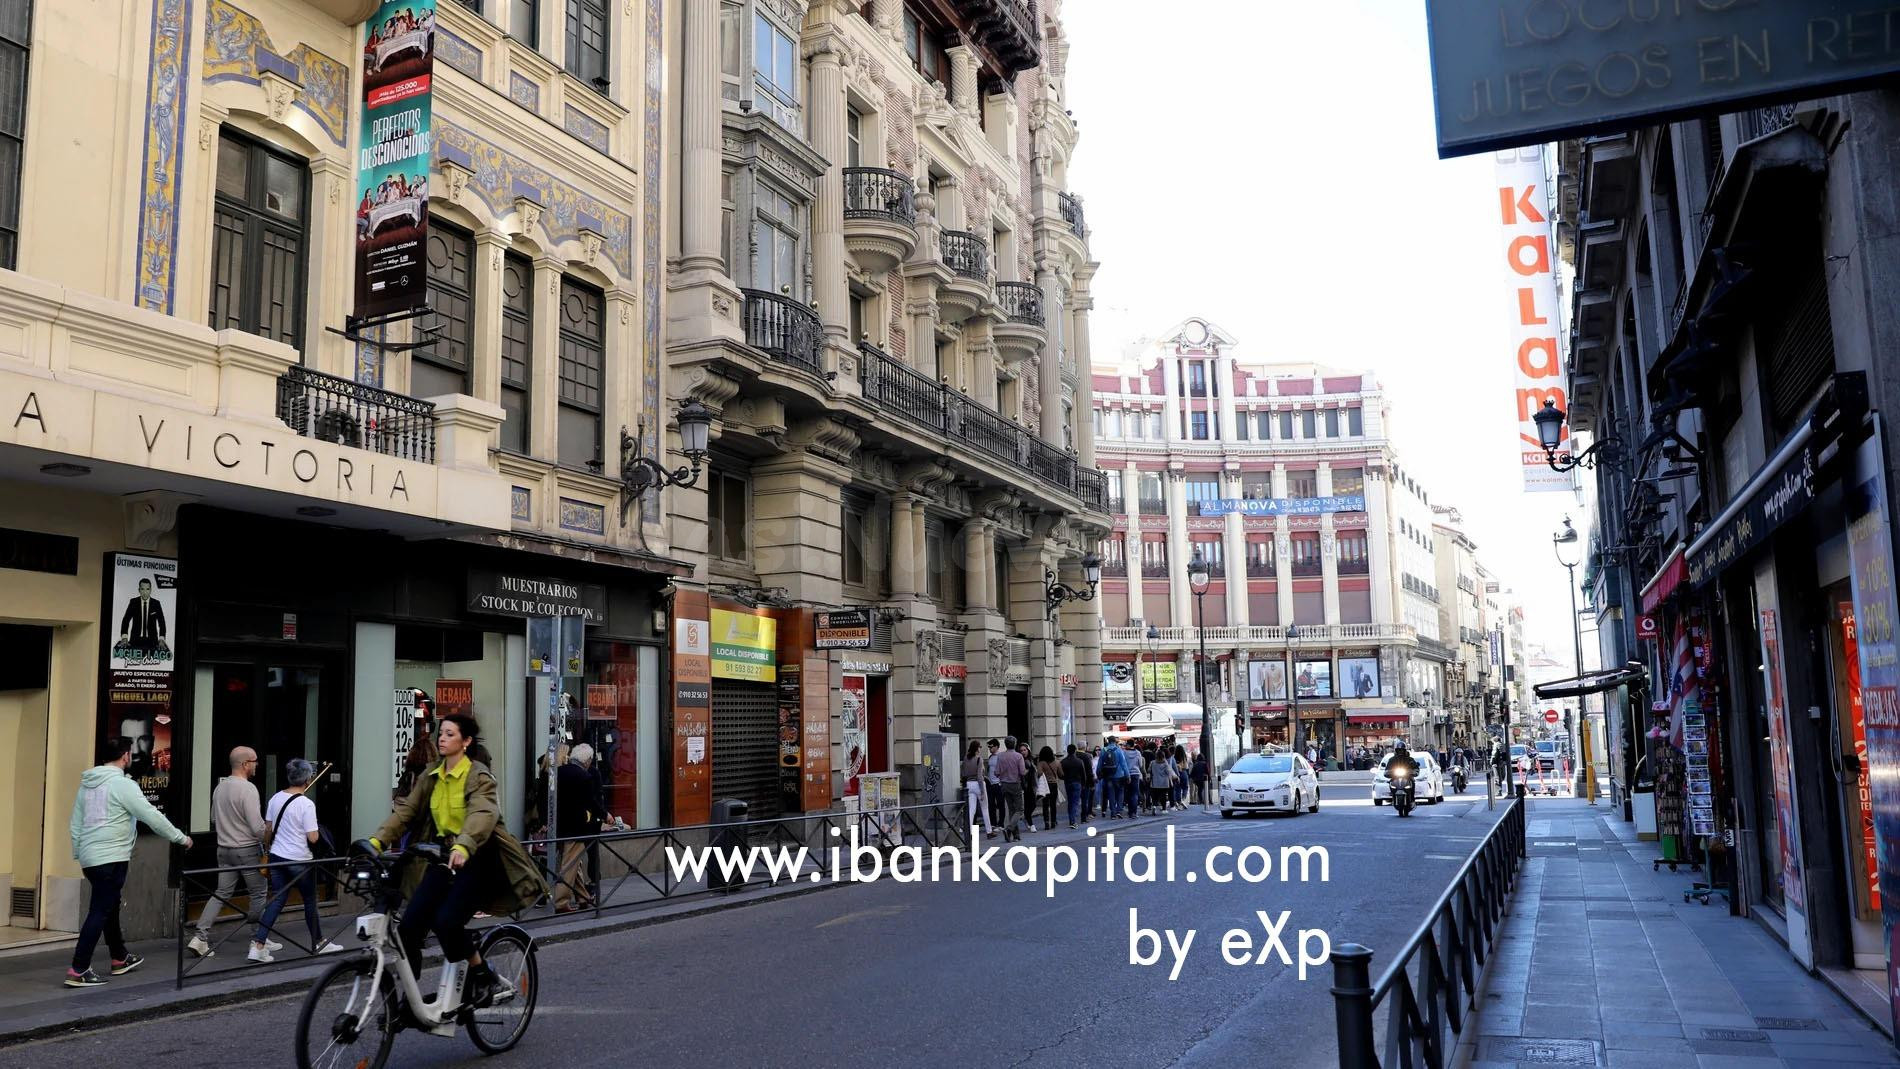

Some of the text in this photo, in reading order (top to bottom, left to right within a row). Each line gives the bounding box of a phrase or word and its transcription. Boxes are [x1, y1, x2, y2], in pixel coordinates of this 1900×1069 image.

[1457, 42, 1671, 124] JUEGOS
[1699, 28, 1772, 83] EN
[372, 108, 421, 145] PERFECTOS
[361, 131, 431, 170] DESCONOCIDOS
[138, 414, 410, 502] VICTORIA
[1281, 497, 1363, 507] DISPONIBLE
[116, 557, 176, 572] ÚLTIMAS FUNCIONES
[501, 576, 578, 600] MUESTRARIOS
[481, 595, 519, 612] STOCK
[522, 600, 535, 613] DE
[820, 629, 867, 638] DISPONIBLE
[716, 647, 769, 661] LOCAL DISPONIBLE
[112, 692, 169, 701] MIGUEL LAGO
[436, 687, 472, 704] REBAJAS
[396, 706, 413, 728] 10€
[1865, 689, 1899, 727] REBAJAS
[141, 775, 169, 789] NEGRO
